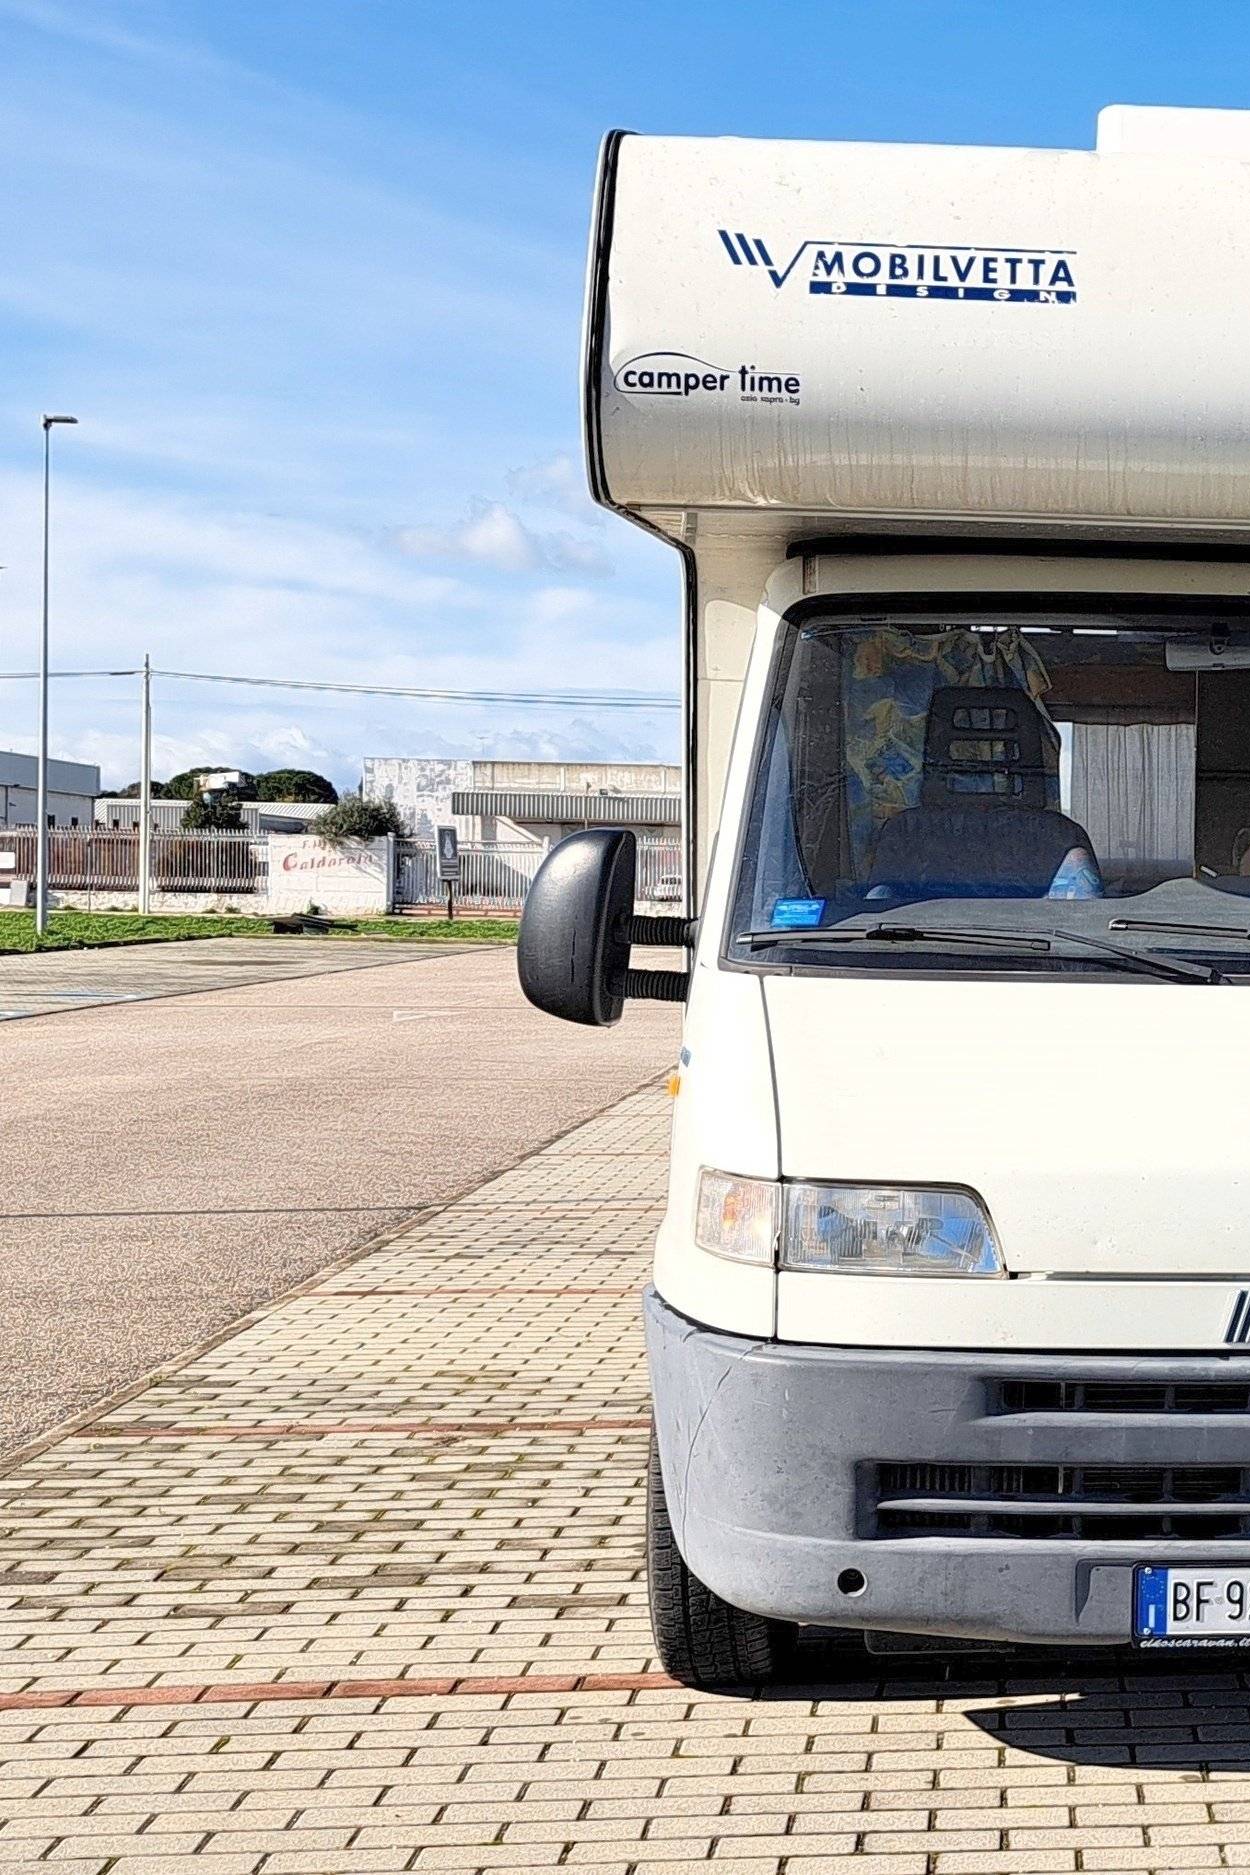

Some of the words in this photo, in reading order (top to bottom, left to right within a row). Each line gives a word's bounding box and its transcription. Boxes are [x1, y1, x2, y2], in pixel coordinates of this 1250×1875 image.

[811, 250, 1076, 287] MOBILVETTA
[830, 281, 1057, 304] DESIGN
[623, 370, 730, 396] camper
[738, 365, 800, 394] time
[1172, 1581, 1215, 1622] BF
